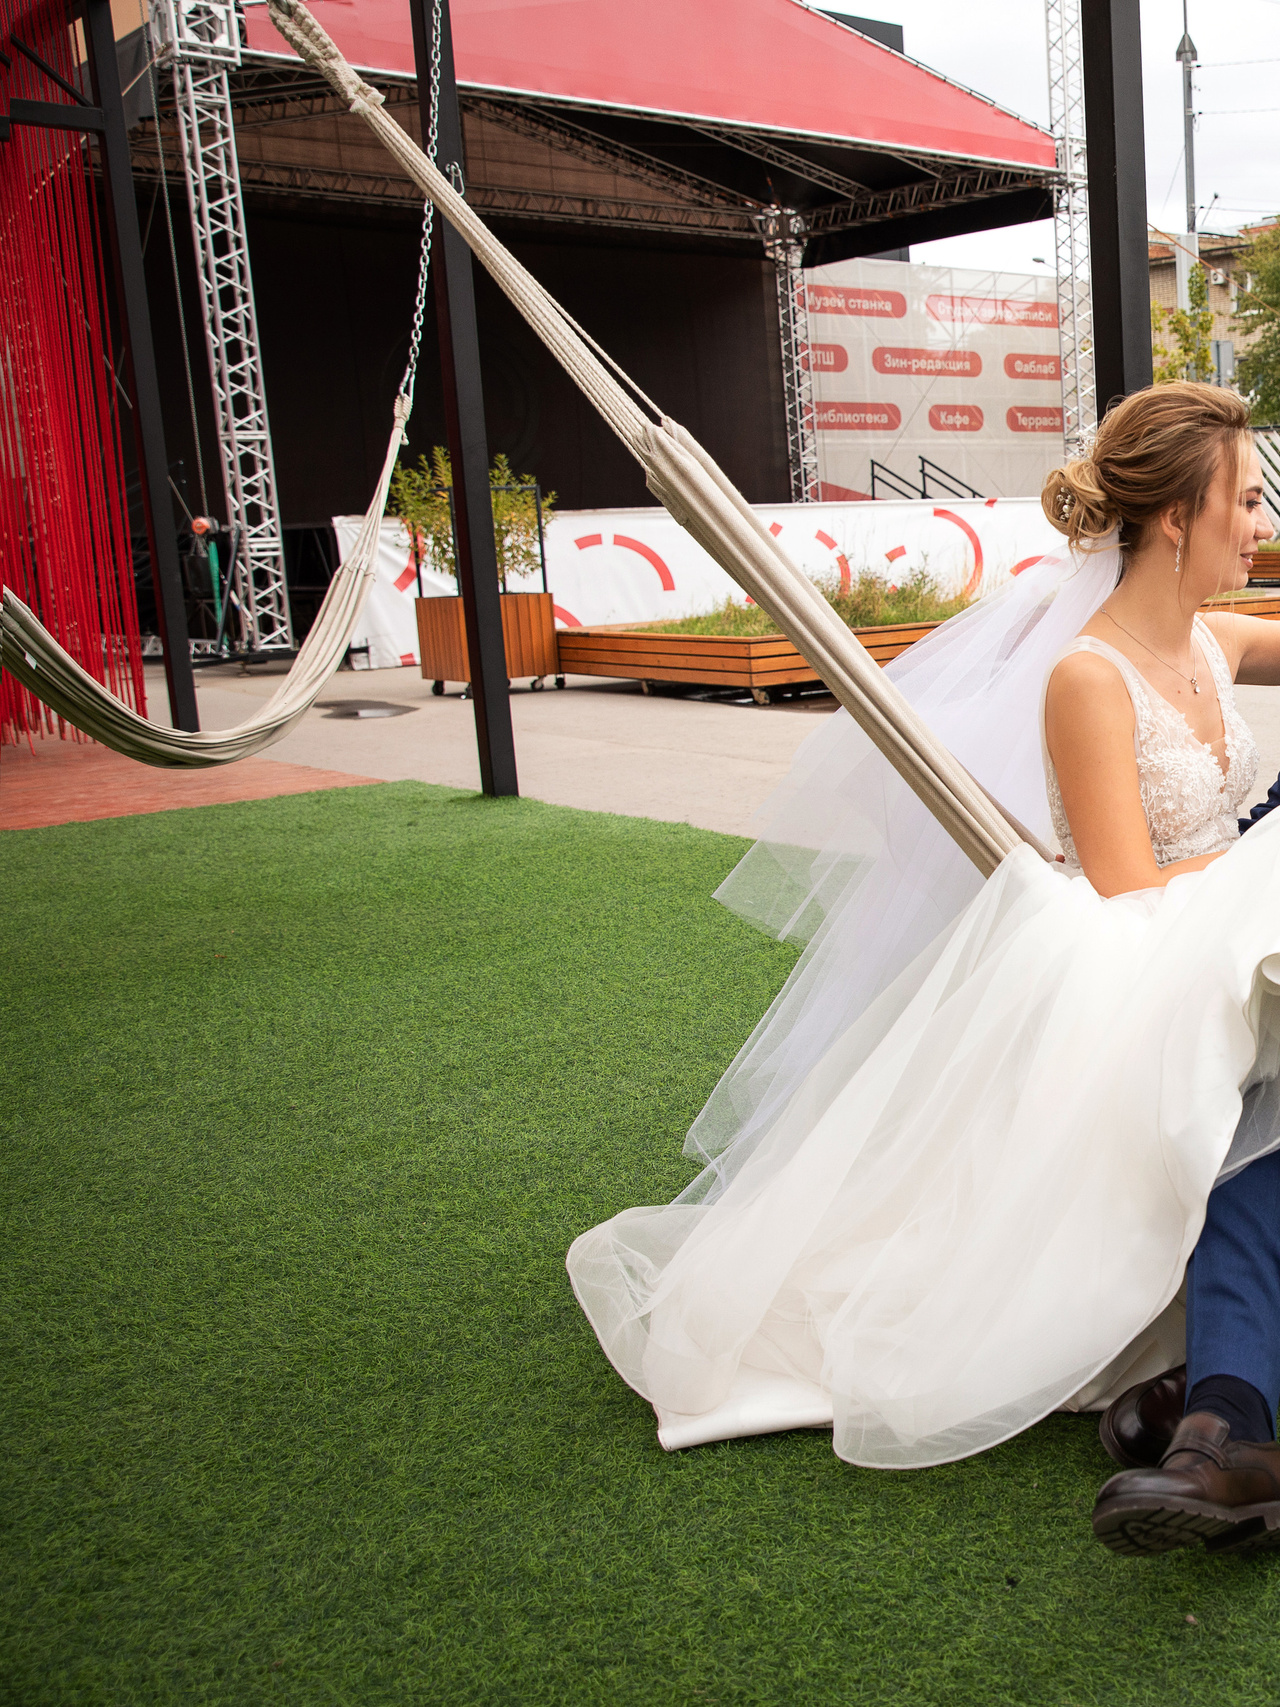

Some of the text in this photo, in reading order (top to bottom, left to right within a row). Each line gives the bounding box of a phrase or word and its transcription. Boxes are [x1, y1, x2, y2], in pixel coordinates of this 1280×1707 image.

[848, 298, 892, 312] станка
[884, 353, 971, 372] Зин-редакция
[1014, 359, 1056, 374] Фаблаб
[940, 411, 970, 428] Кафе
[1016, 412, 1061, 429] Терраса
